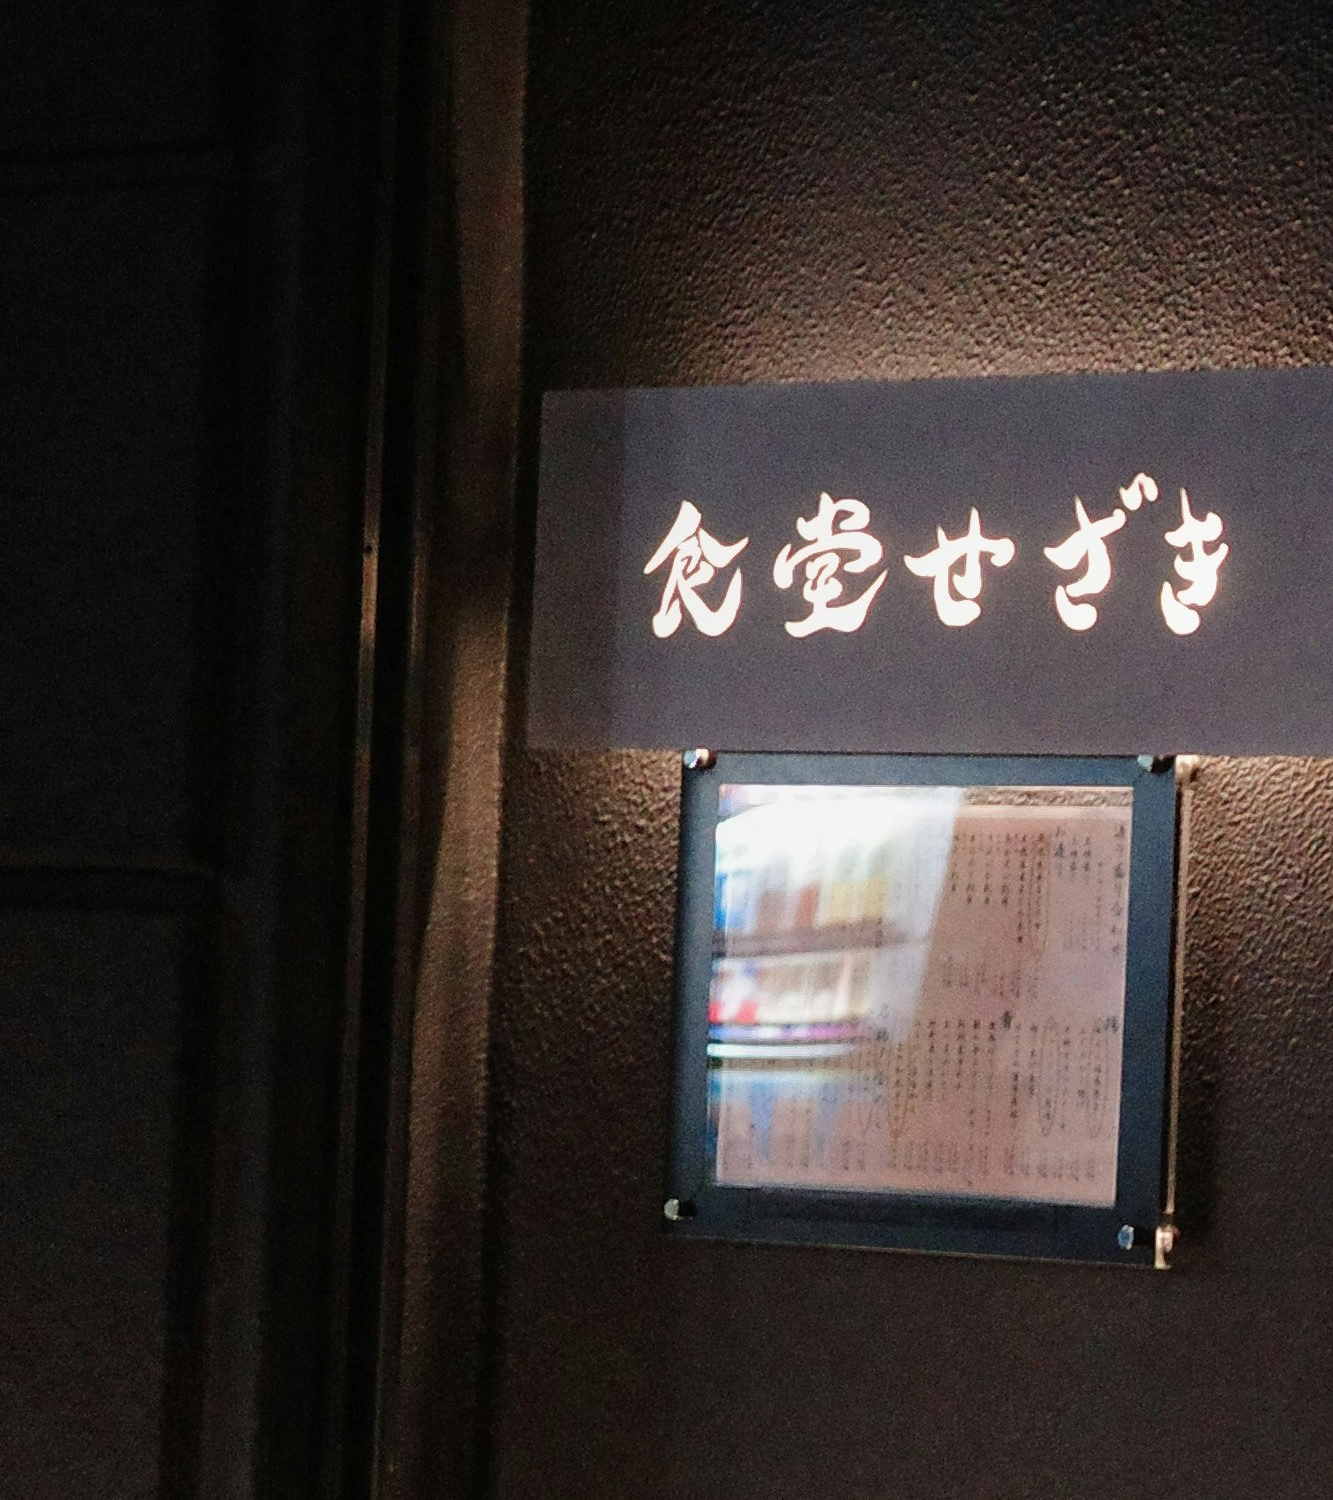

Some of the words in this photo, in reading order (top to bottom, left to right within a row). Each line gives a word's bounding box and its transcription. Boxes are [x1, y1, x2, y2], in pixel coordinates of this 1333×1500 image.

[643, 471, 1231, 639] 食堂せざき
